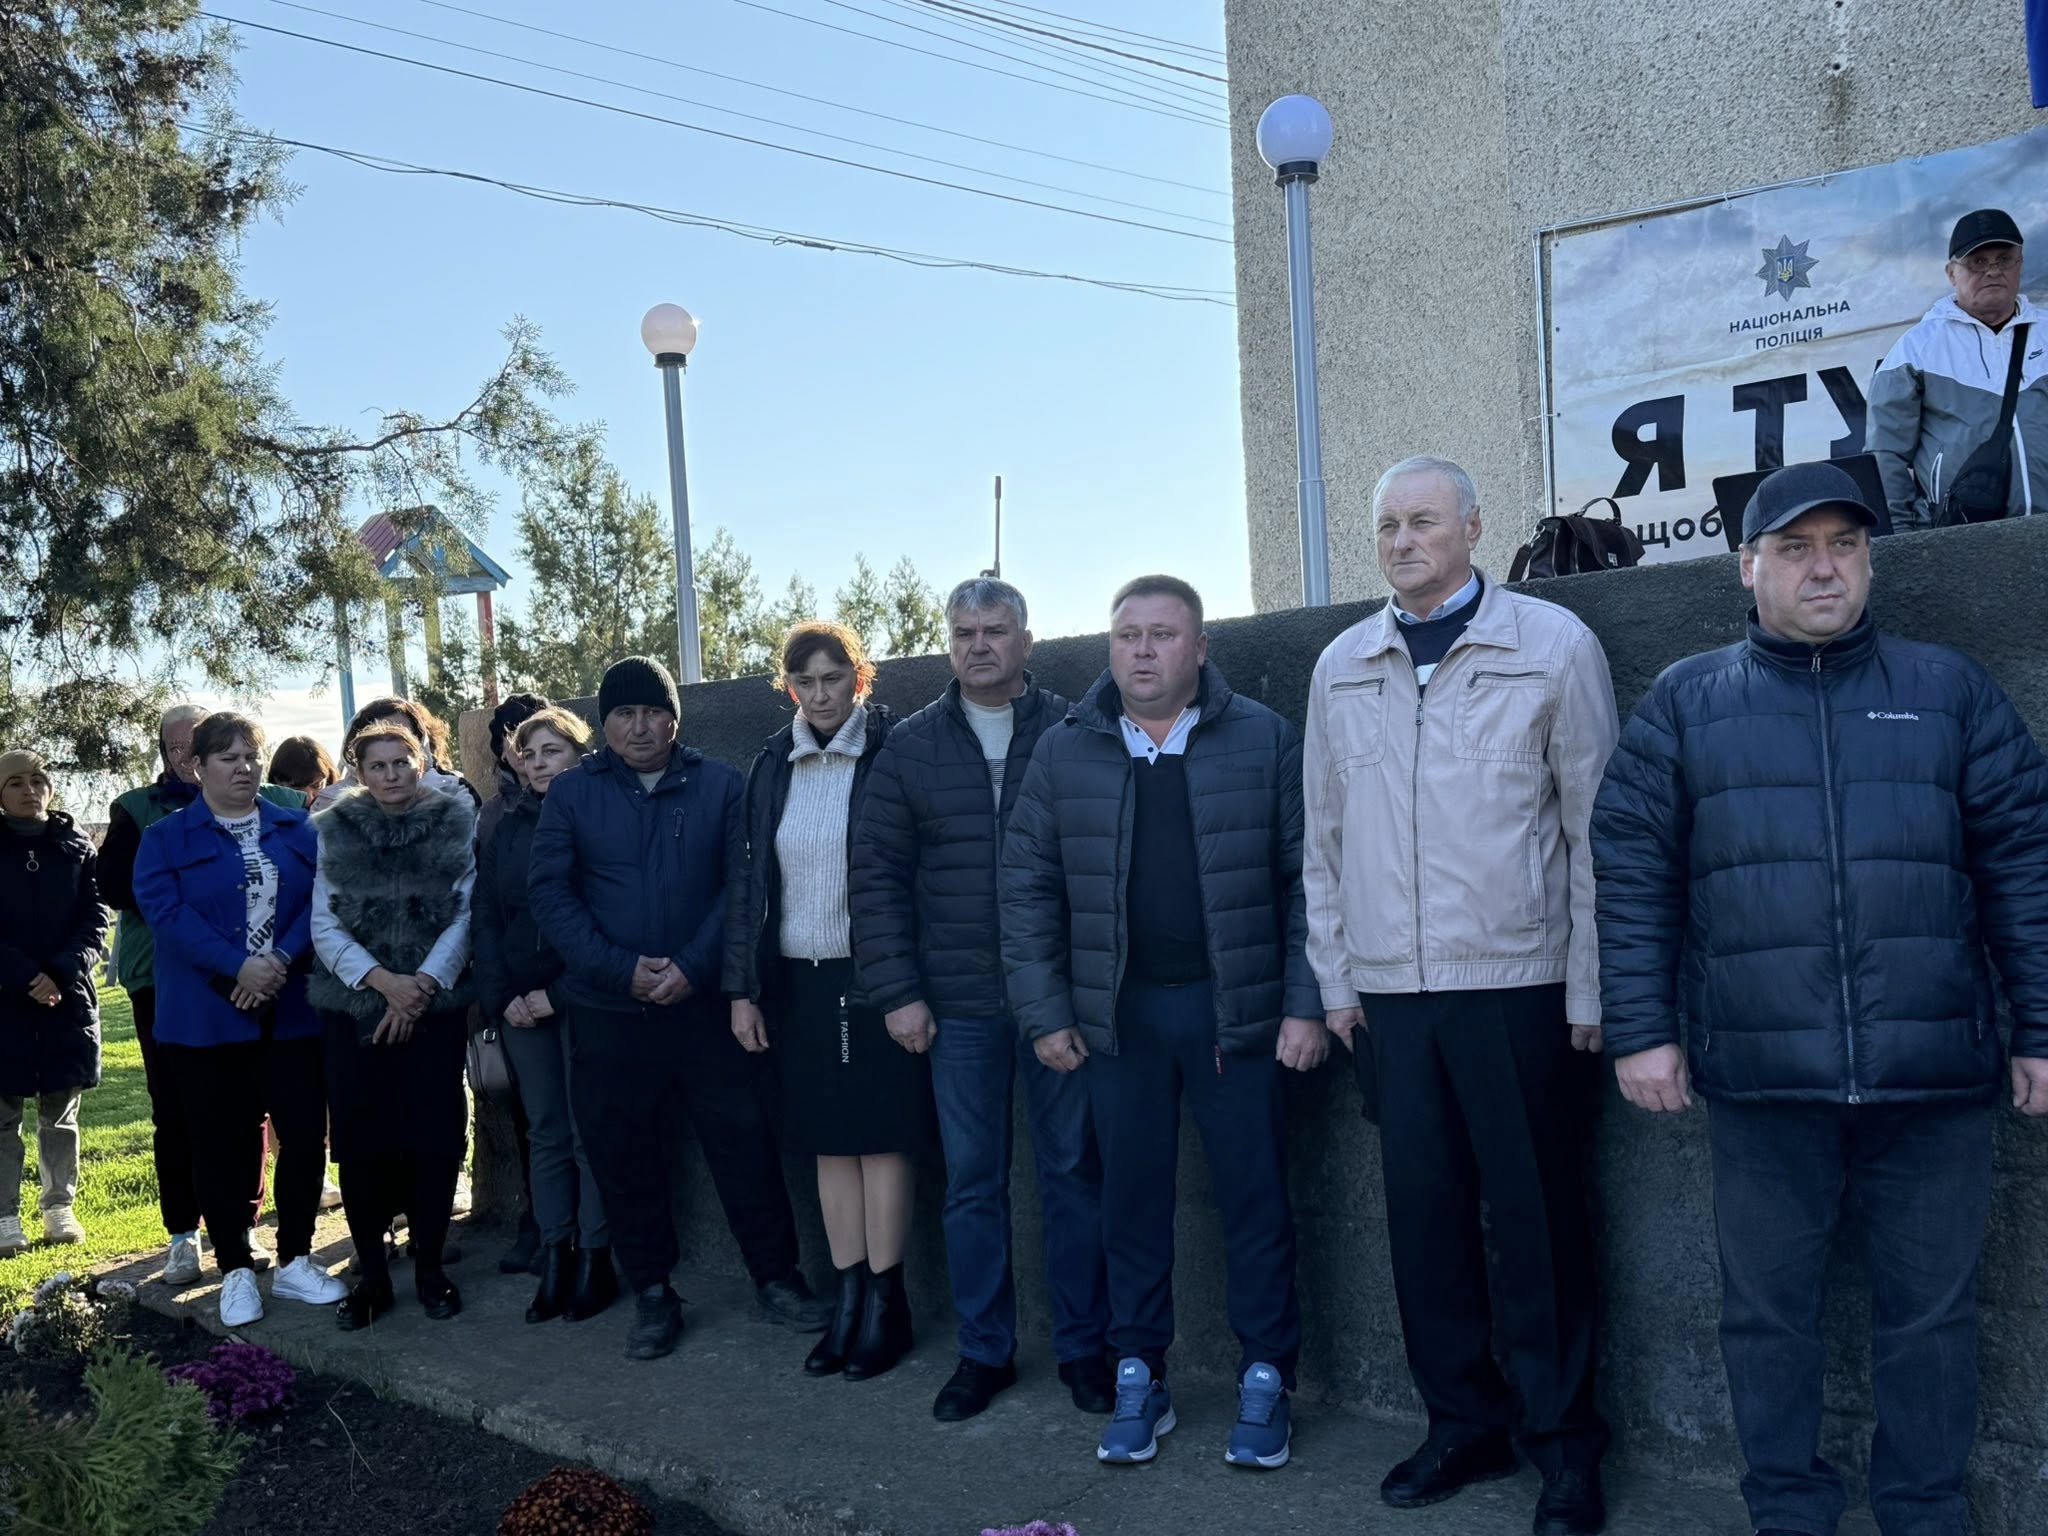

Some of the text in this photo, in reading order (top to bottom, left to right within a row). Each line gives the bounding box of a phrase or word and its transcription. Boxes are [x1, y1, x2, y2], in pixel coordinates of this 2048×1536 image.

[1729, 300, 1851, 333] НАЦІОНАЛЬНА
[1756, 327, 1824, 350] ПОЛІЦІЯ
[1612, 394, 1687, 499] Я
[1637, 505, 1723, 549] щоб
[1876, 711, 1920, 721] Columbia
[840, 1021, 849, 1063] FASHION
